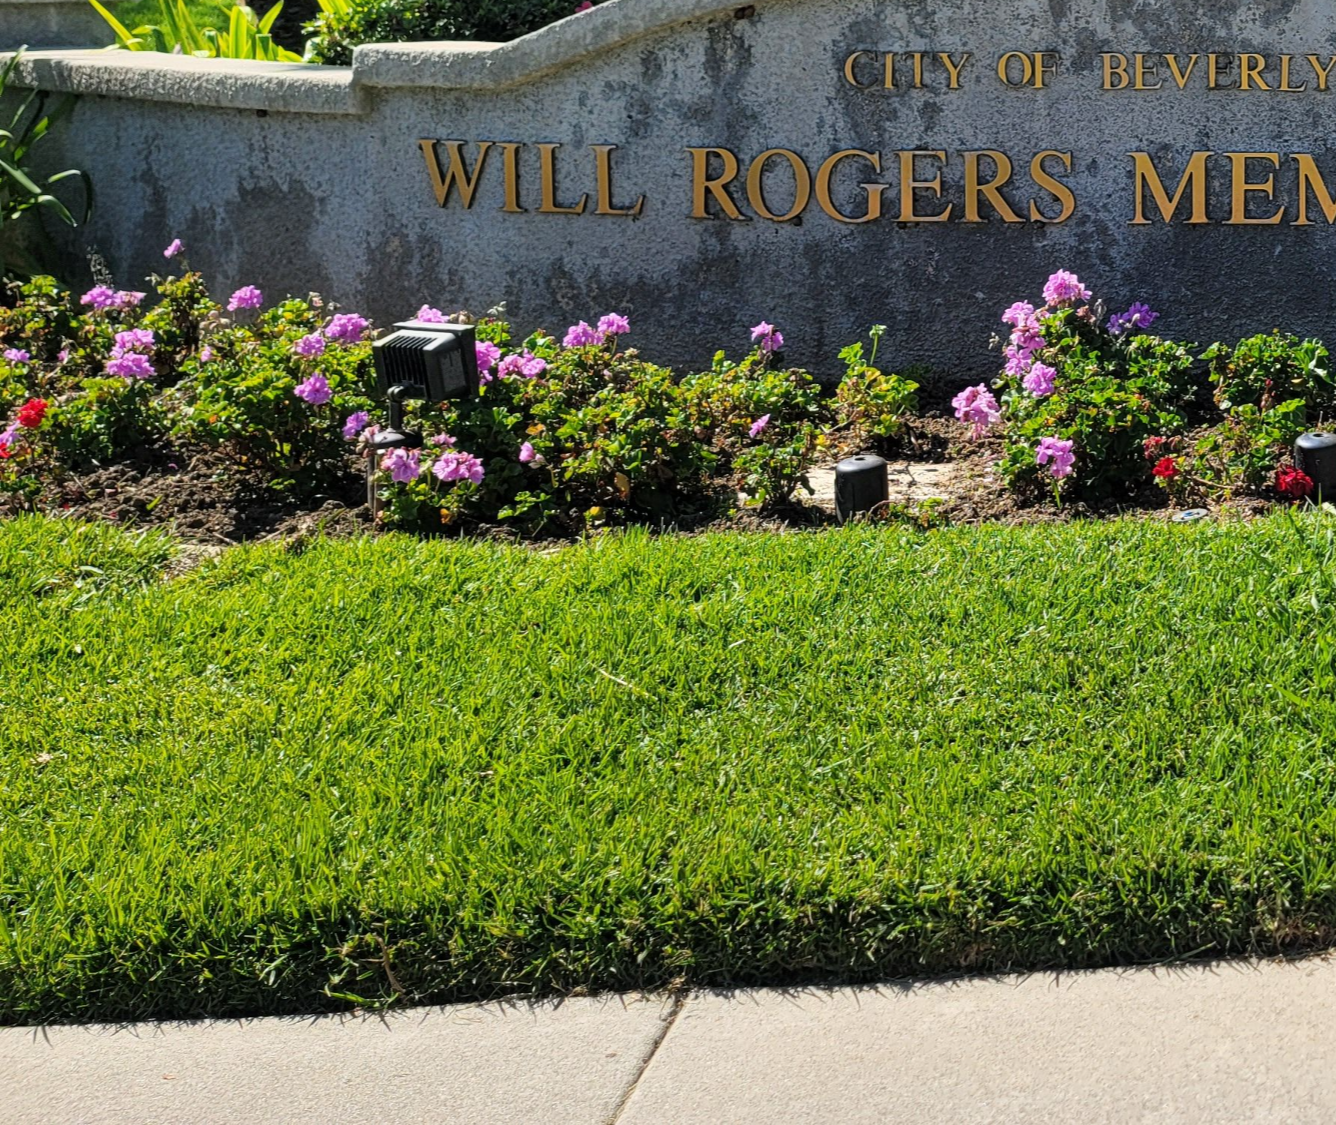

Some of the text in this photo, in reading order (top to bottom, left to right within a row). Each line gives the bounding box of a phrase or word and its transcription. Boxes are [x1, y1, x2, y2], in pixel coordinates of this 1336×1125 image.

[843, 52, 970, 90] CITY
[998, 52, 1061, 89] OF
[419, 139, 646, 216] WILL
[686, 147, 1077, 226] ROGERS
